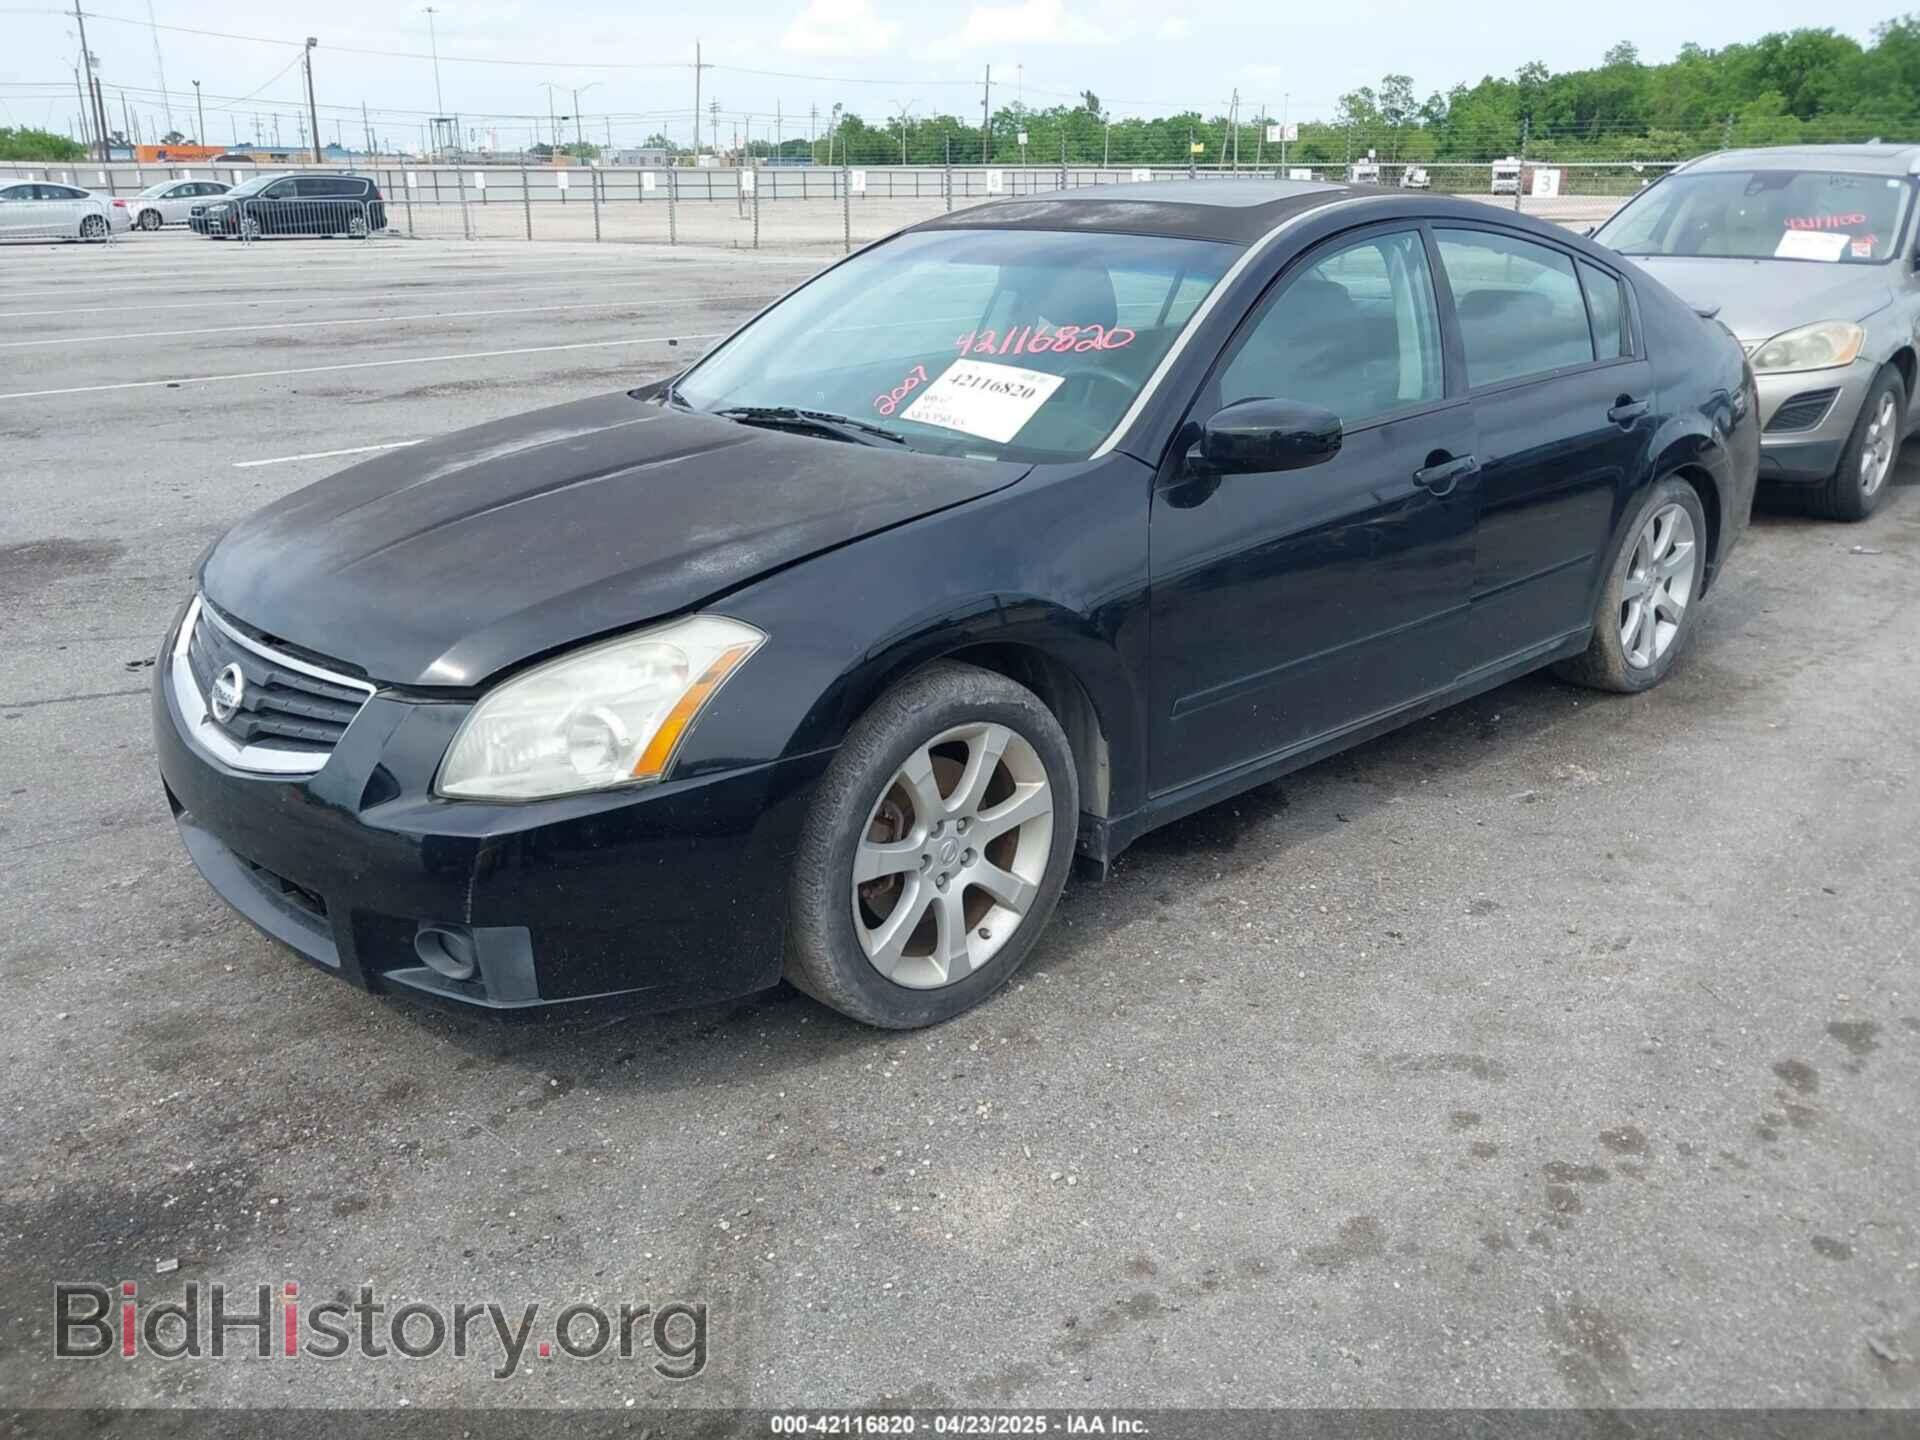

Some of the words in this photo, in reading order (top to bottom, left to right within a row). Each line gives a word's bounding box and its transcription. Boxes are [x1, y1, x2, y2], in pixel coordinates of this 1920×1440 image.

[1541, 175, 1551, 192] 3
[955, 324, 1136, 356] 42116820
[873, 364, 928, 416] 2007
[949, 373, 1036, 400] 42116820
